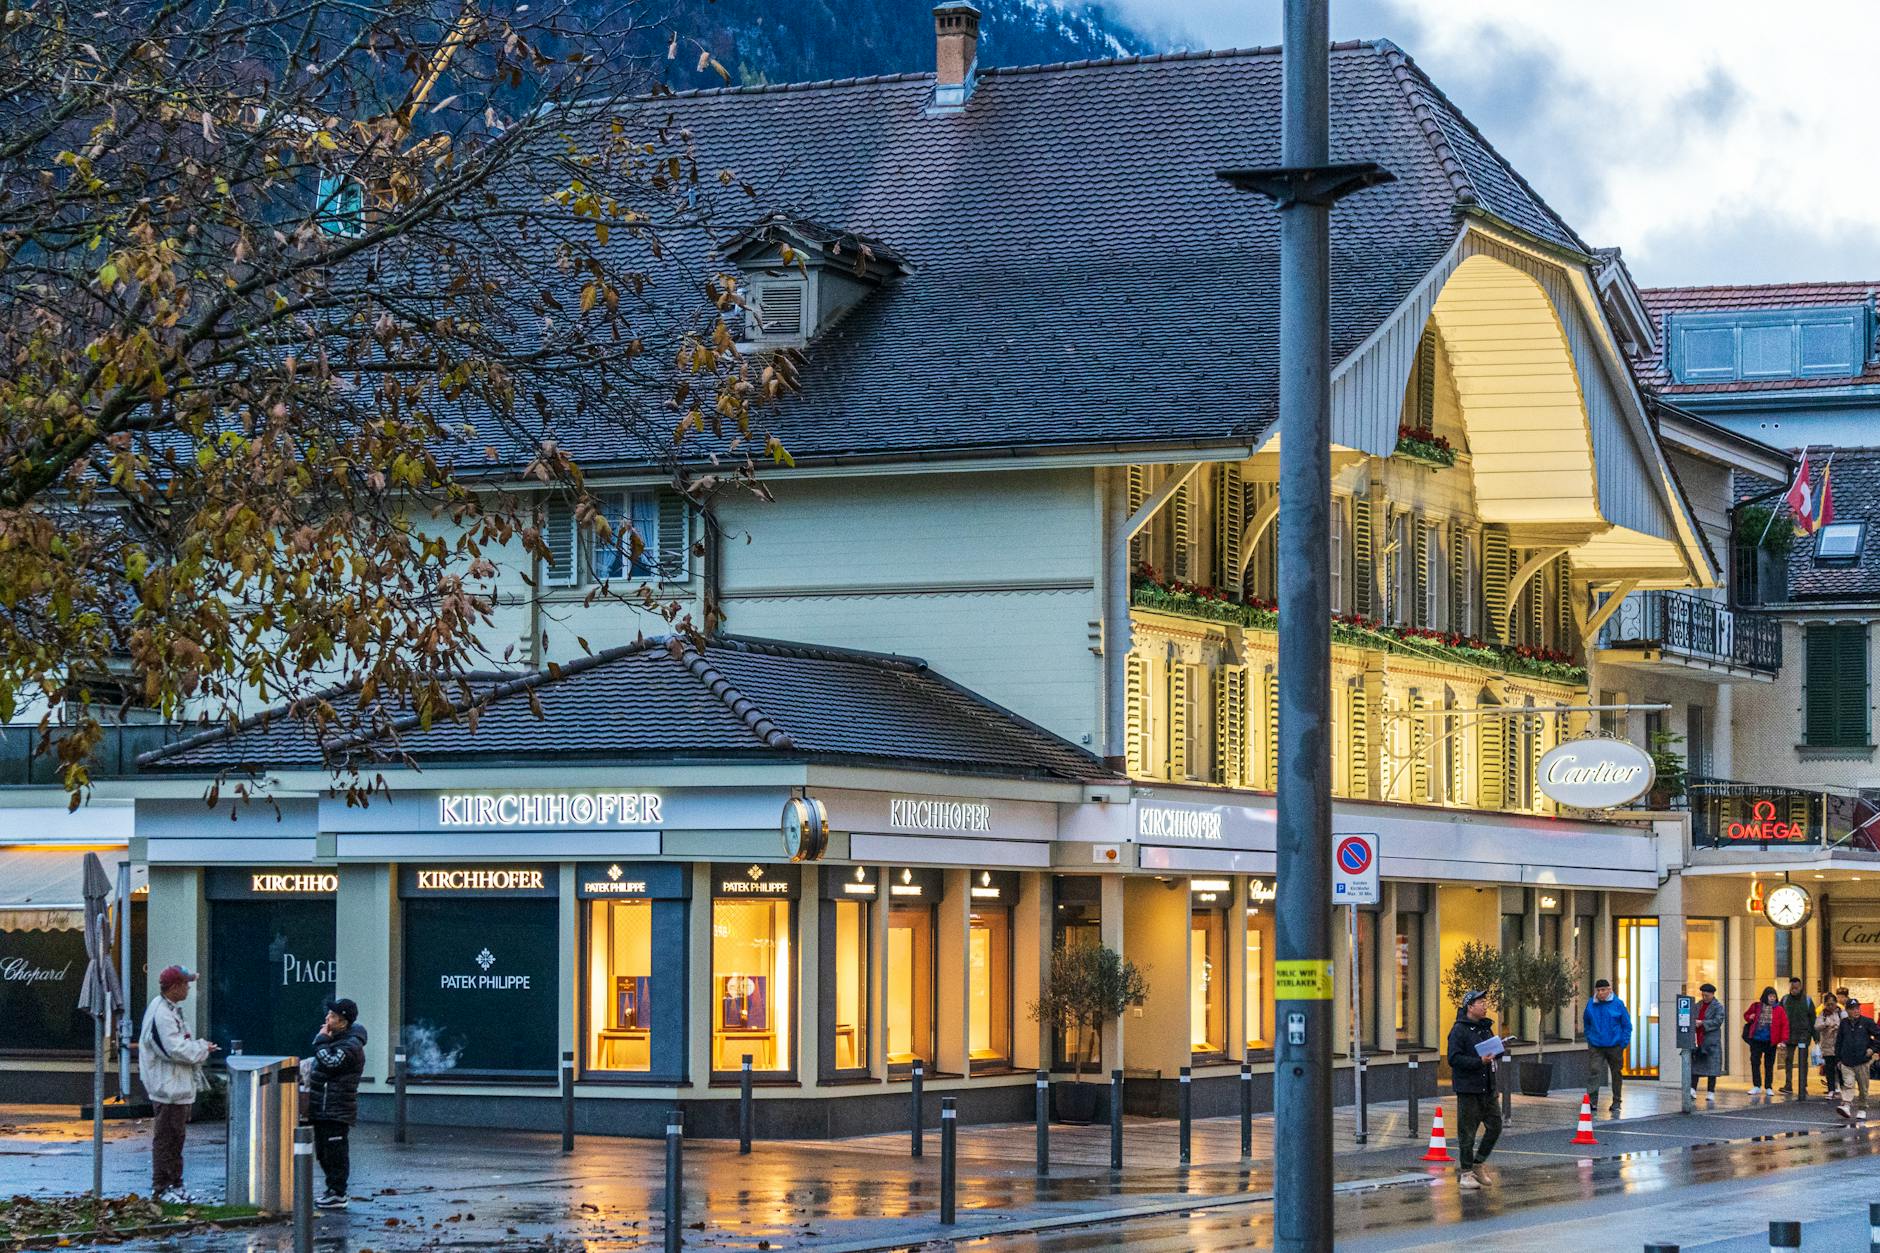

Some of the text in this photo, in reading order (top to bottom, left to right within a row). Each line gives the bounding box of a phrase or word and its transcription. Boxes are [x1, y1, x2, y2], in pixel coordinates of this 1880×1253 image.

[1548, 756, 1642, 785] Cartier
[439, 793, 664, 826] KIRCHHOFER
[889, 799, 991, 832] KIRCHHOFER
[1139, 807, 1222, 840] KIRCHHOFER
[1728, 822, 1804, 840] OMEGA
[251, 874, 339, 892] KIRCHHO
[417, 870, 544, 889] KIRCHHOFER
[584, 882, 646, 893] PATEK PHILIPPE
[723, 882, 788, 893] PATEK PHILIPPE
[0, 956, 72, 986] Chopard
[1299, 969, 1317, 977] WIFI
[441, 975, 531, 990] PATEK PHILIPPE
